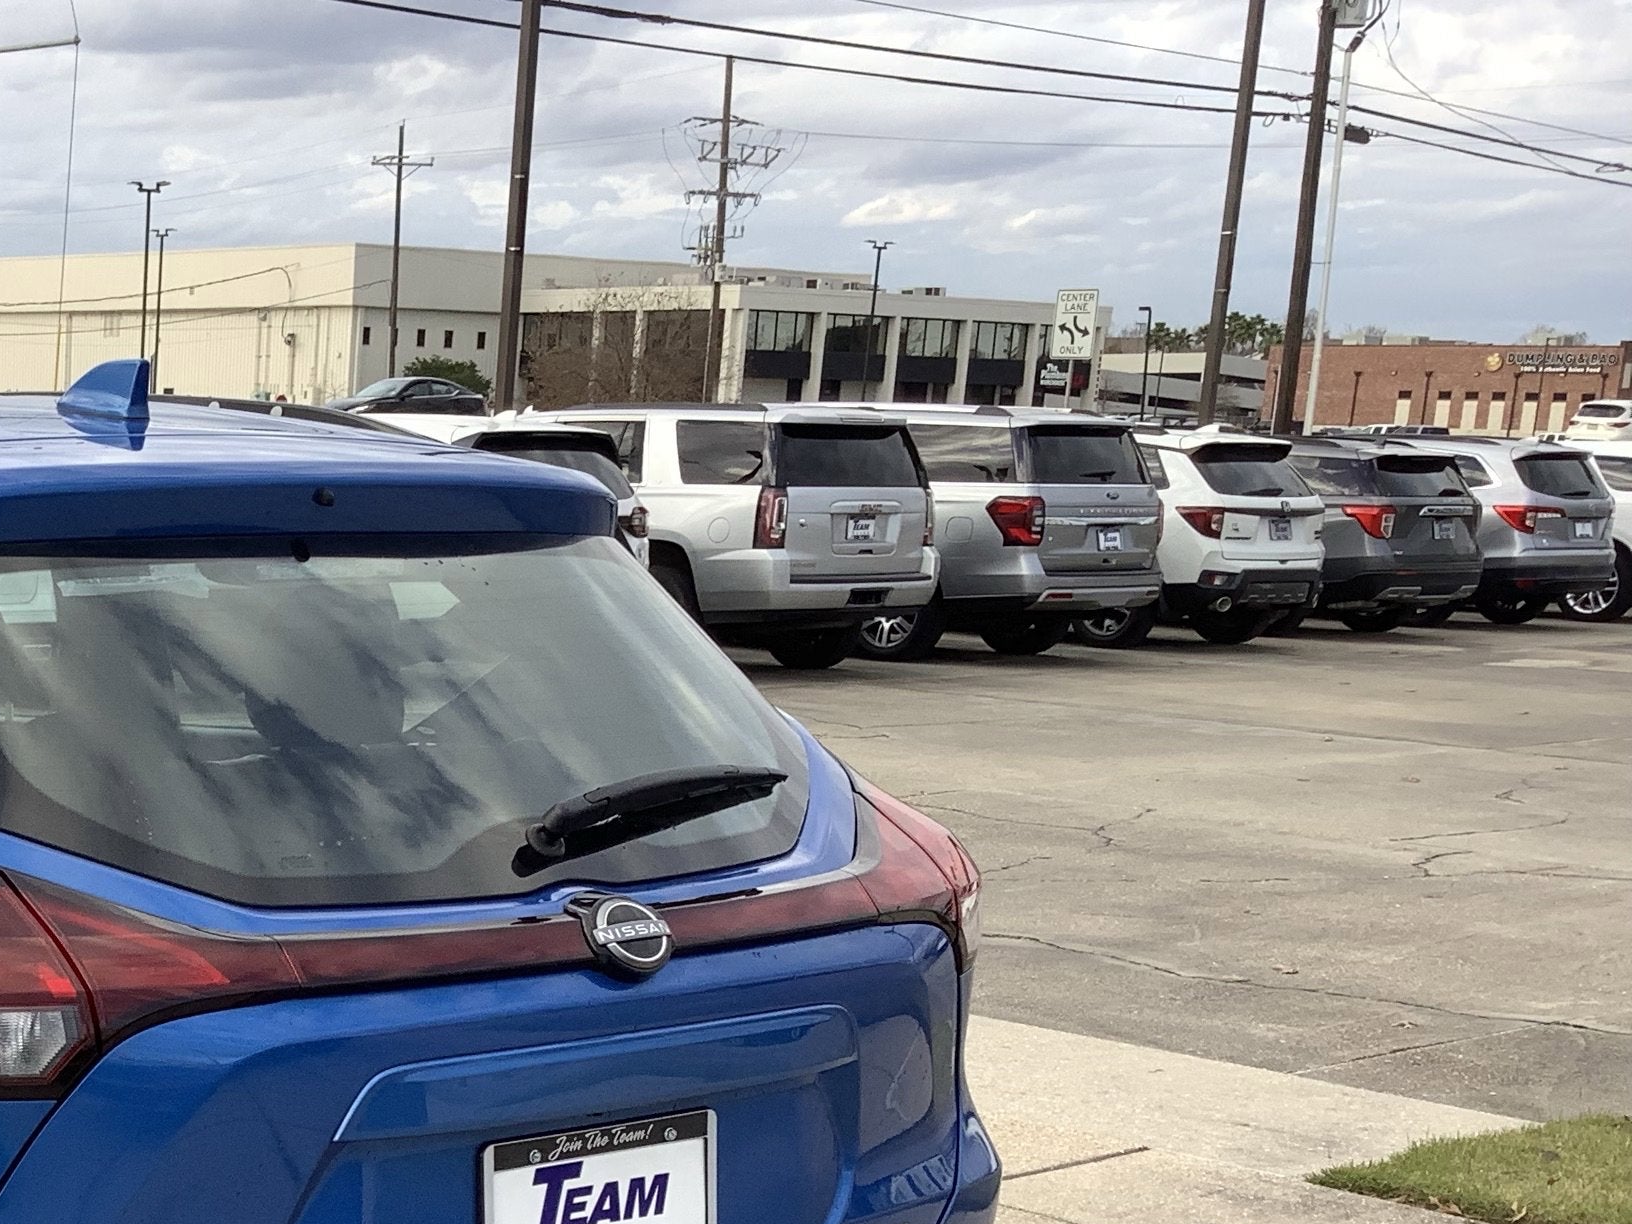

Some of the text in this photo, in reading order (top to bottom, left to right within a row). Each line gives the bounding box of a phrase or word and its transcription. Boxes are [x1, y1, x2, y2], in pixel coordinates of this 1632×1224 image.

[1060, 293, 1096, 302] CENTER
[1064, 302, 1089, 312] LANE
[1059, 346, 1084, 355] ONLY
[1506, 351, 1619, 366] DUMPLING & BAO
[598, 922, 671, 943] NISSAN
[548, 1124, 654, 1161] Join The Team!
